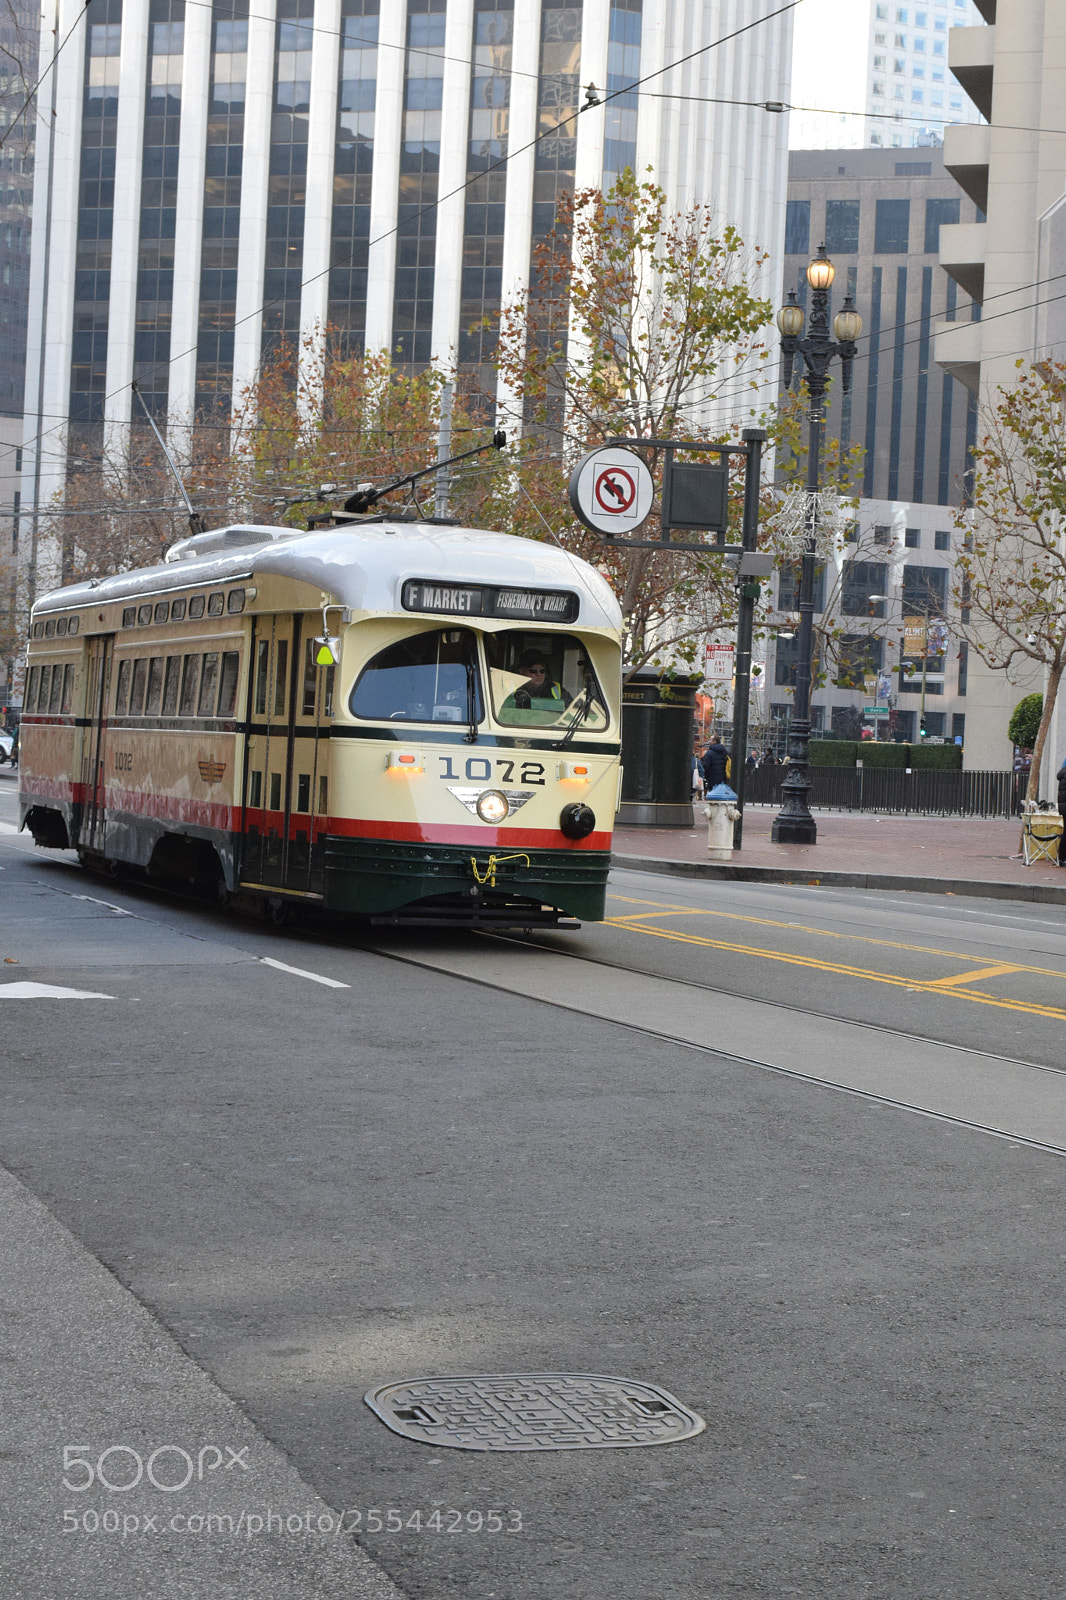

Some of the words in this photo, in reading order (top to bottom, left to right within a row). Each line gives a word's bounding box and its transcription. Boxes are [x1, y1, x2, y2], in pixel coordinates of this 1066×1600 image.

[409, 587, 418, 606] F
[423, 587, 473, 611] MARKET
[496, 592, 541, 611] FISHERMAN'S
[543, 595, 568, 612] WHARF
[706, 651, 715, 659] NO
[115, 752, 132, 770] 1072
[438, 756, 546, 786] 1072
